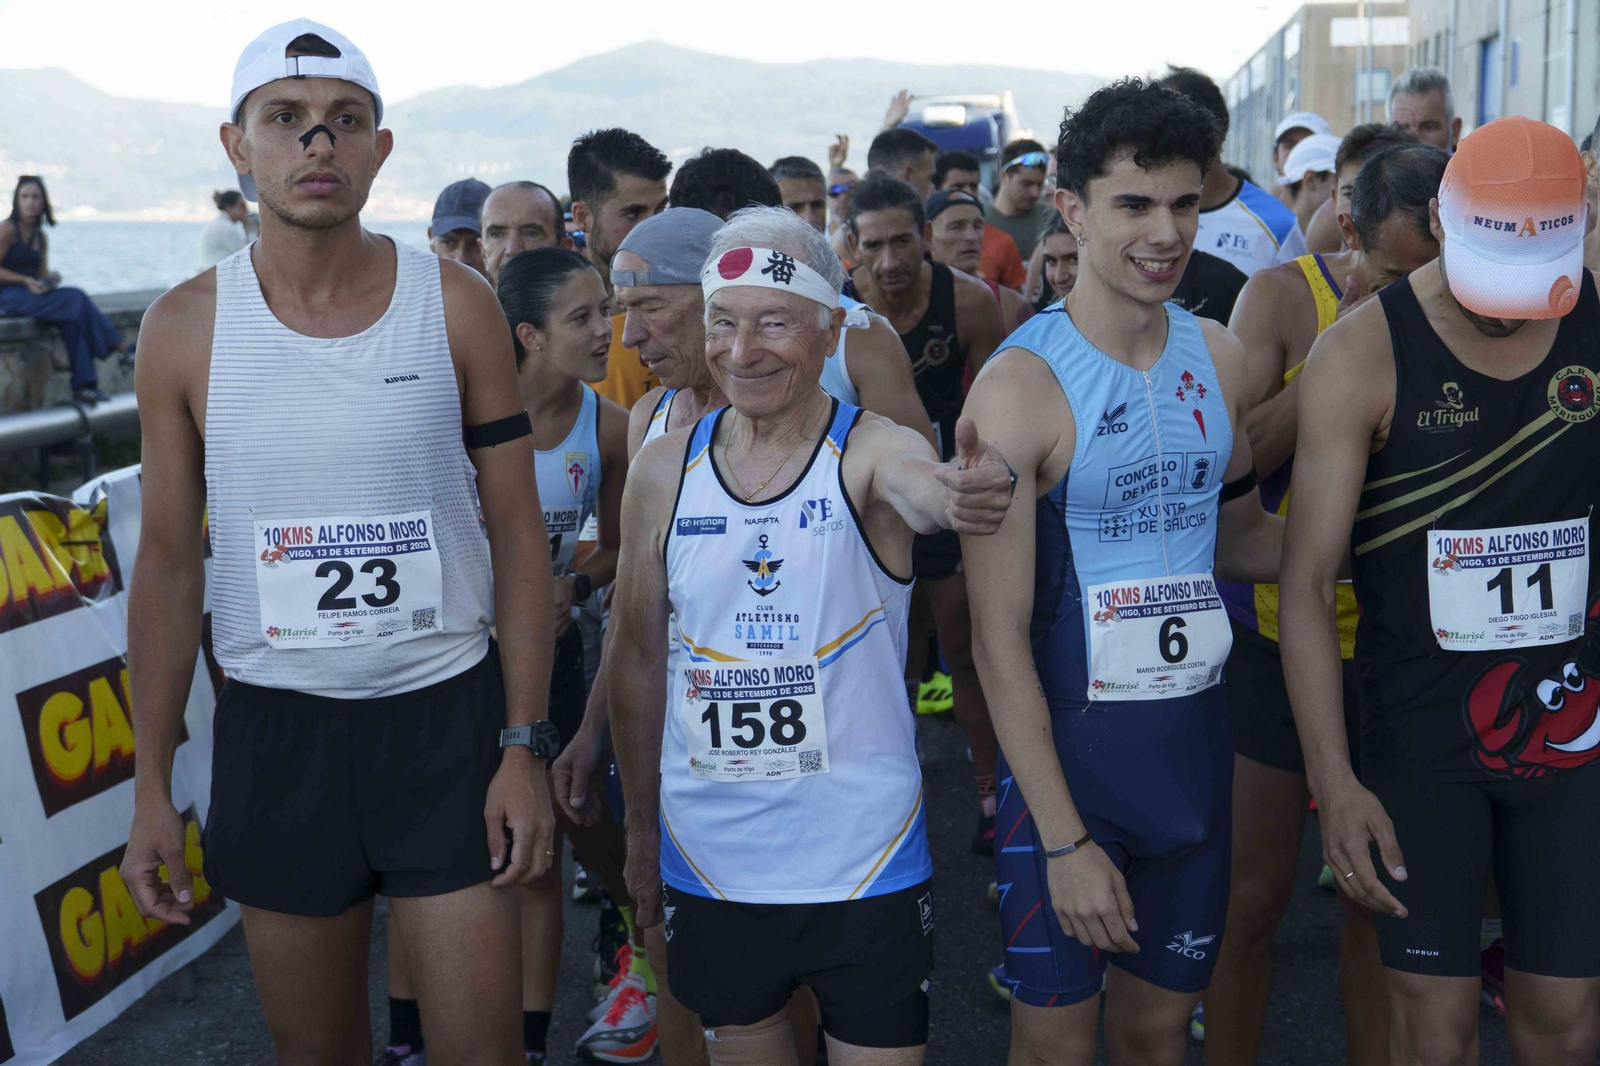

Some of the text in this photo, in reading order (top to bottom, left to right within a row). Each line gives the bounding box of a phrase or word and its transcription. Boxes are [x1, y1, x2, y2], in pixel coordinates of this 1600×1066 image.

[384, 374, 420, 384] KIPRUN
[1417, 407, 1479, 428] El Trigal
[1097, 422, 1129, 437] ZICO
[1115, 460, 1177, 488] CONCELLO
[1122, 488, 1139, 501] DE
[553, 510, 578, 523] MORO
[1138, 502, 1186, 520] XUNTA
[693, 518, 726, 526] HYUNDAI
[1138, 512, 1207, 534] DE GALICIA
[264, 518, 427, 546] 10KMS ALFONSO MORO
[1437, 525, 1585, 555] 10KMS ALFONSO MORO
[289, 549, 314, 559] VIGO,
[316, 548, 327, 557] 13
[329, 547, 342, 556] DE
[344, 545, 393, 556] SETEMBRO
[396, 543, 408, 552] DE
[1459, 559, 1485, 568] VIGO,
[1486, 557, 1496, 565] 13
[1499, 556, 1510, 564] DE
[1512, 552, 1554, 563] SETEMBRO
[1556, 550, 1567, 558] DE
[315, 558, 401, 611] 23
[1487, 563, 1553, 615] 11
[1097, 587, 1140, 607] 10KMS
[1144, 581, 1191, 603] ALFONSO
[318, 606, 400, 619] FELIPE RAMOS CORREIA
[735, 613, 800, 623] ATLETISMO
[1120, 609, 1140, 617] VIGO,
[1164, 603, 1197, 613] SETEMBRO
[1509, 614, 1529, 622] TRIGO
[1530, 611, 1557, 620] IGLESIAS
[351, 628, 364, 637] Vigo
[377, 630, 394, 638] ADN
[735, 624, 799, 641] SAMIL
[1159, 616, 1188, 664] 6
[1187, 661, 1206, 669] COSTAS
[714, 667, 770, 687] ALFONSO
[775, 664, 815, 683] MORO
[713, 690, 721, 699] 13
[723, 690, 732, 698] DE
[734, 688, 777, 699] SETEMBRO
[780, 687, 791, 695] DE
[702, 699, 807, 749] 158
[1166, 941, 1206, 960] ZICO
[1406, 948, 1439, 956] KIPRUN
